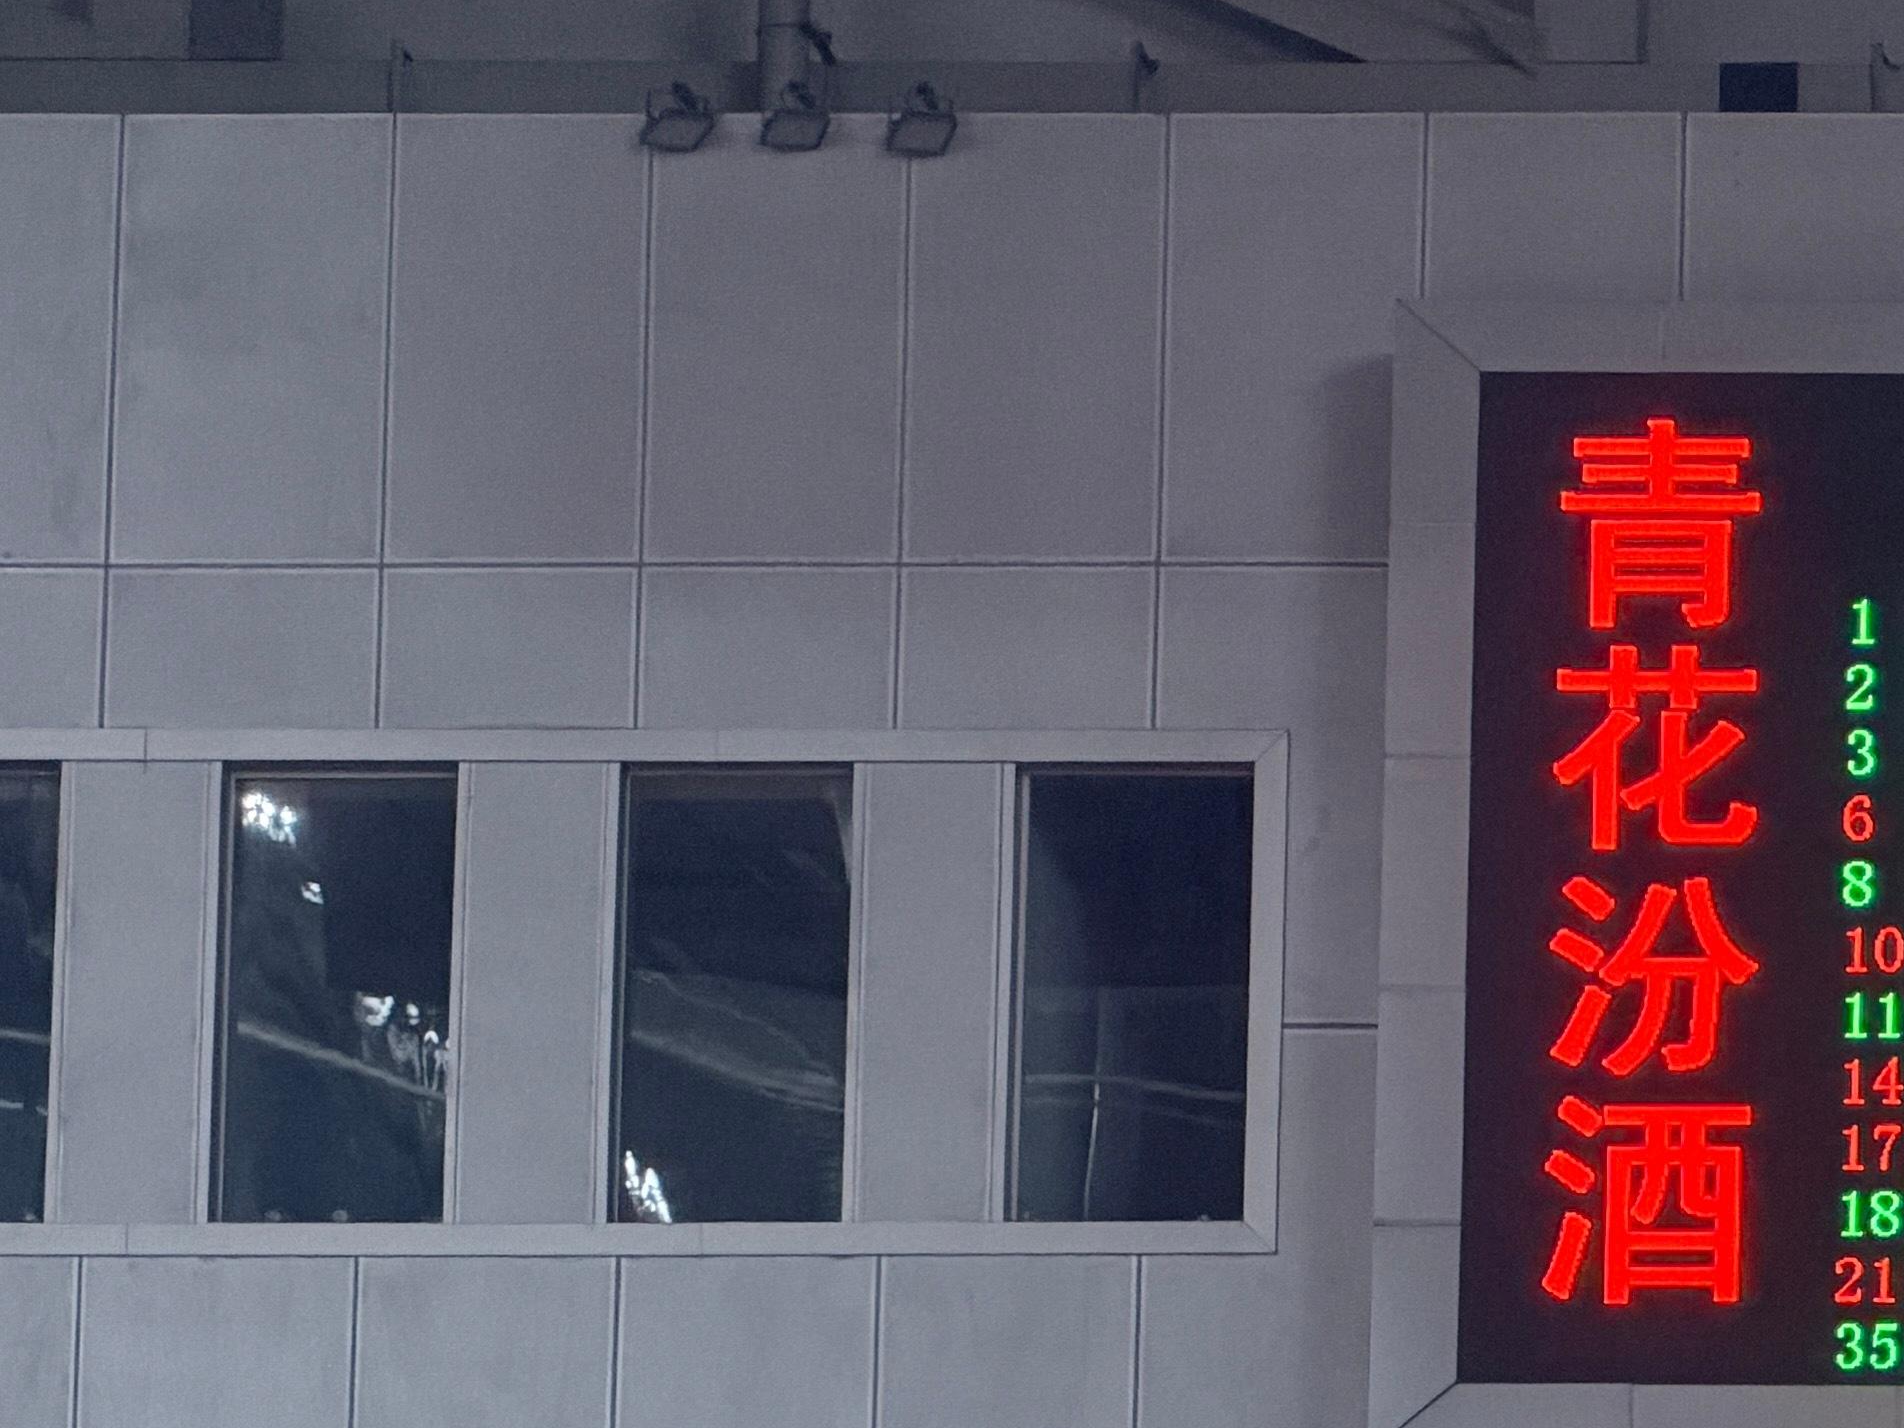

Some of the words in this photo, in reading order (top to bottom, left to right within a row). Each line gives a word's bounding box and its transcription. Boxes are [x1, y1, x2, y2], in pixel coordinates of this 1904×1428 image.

[1852, 599, 1874, 644] 1
[1846, 664, 1875, 710] 2
[1848, 730, 1875, 775] 3
[1843, 795, 1873, 841] 6
[1542, 418, 1762, 1305] 青花汾酒
[1843, 861, 1873, 906] 8
[1846, 927, 1904, 972] 10
[1845, 993, 1900, 1038] 11
[1844, 1057, 1904, 1105] 14
[1843, 1124, 1901, 1170] 17
[1841, 1191, 1900, 1237] 18
[1835, 1257, 1895, 1303] 21
[1836, 1323, 1898, 1369] 35
